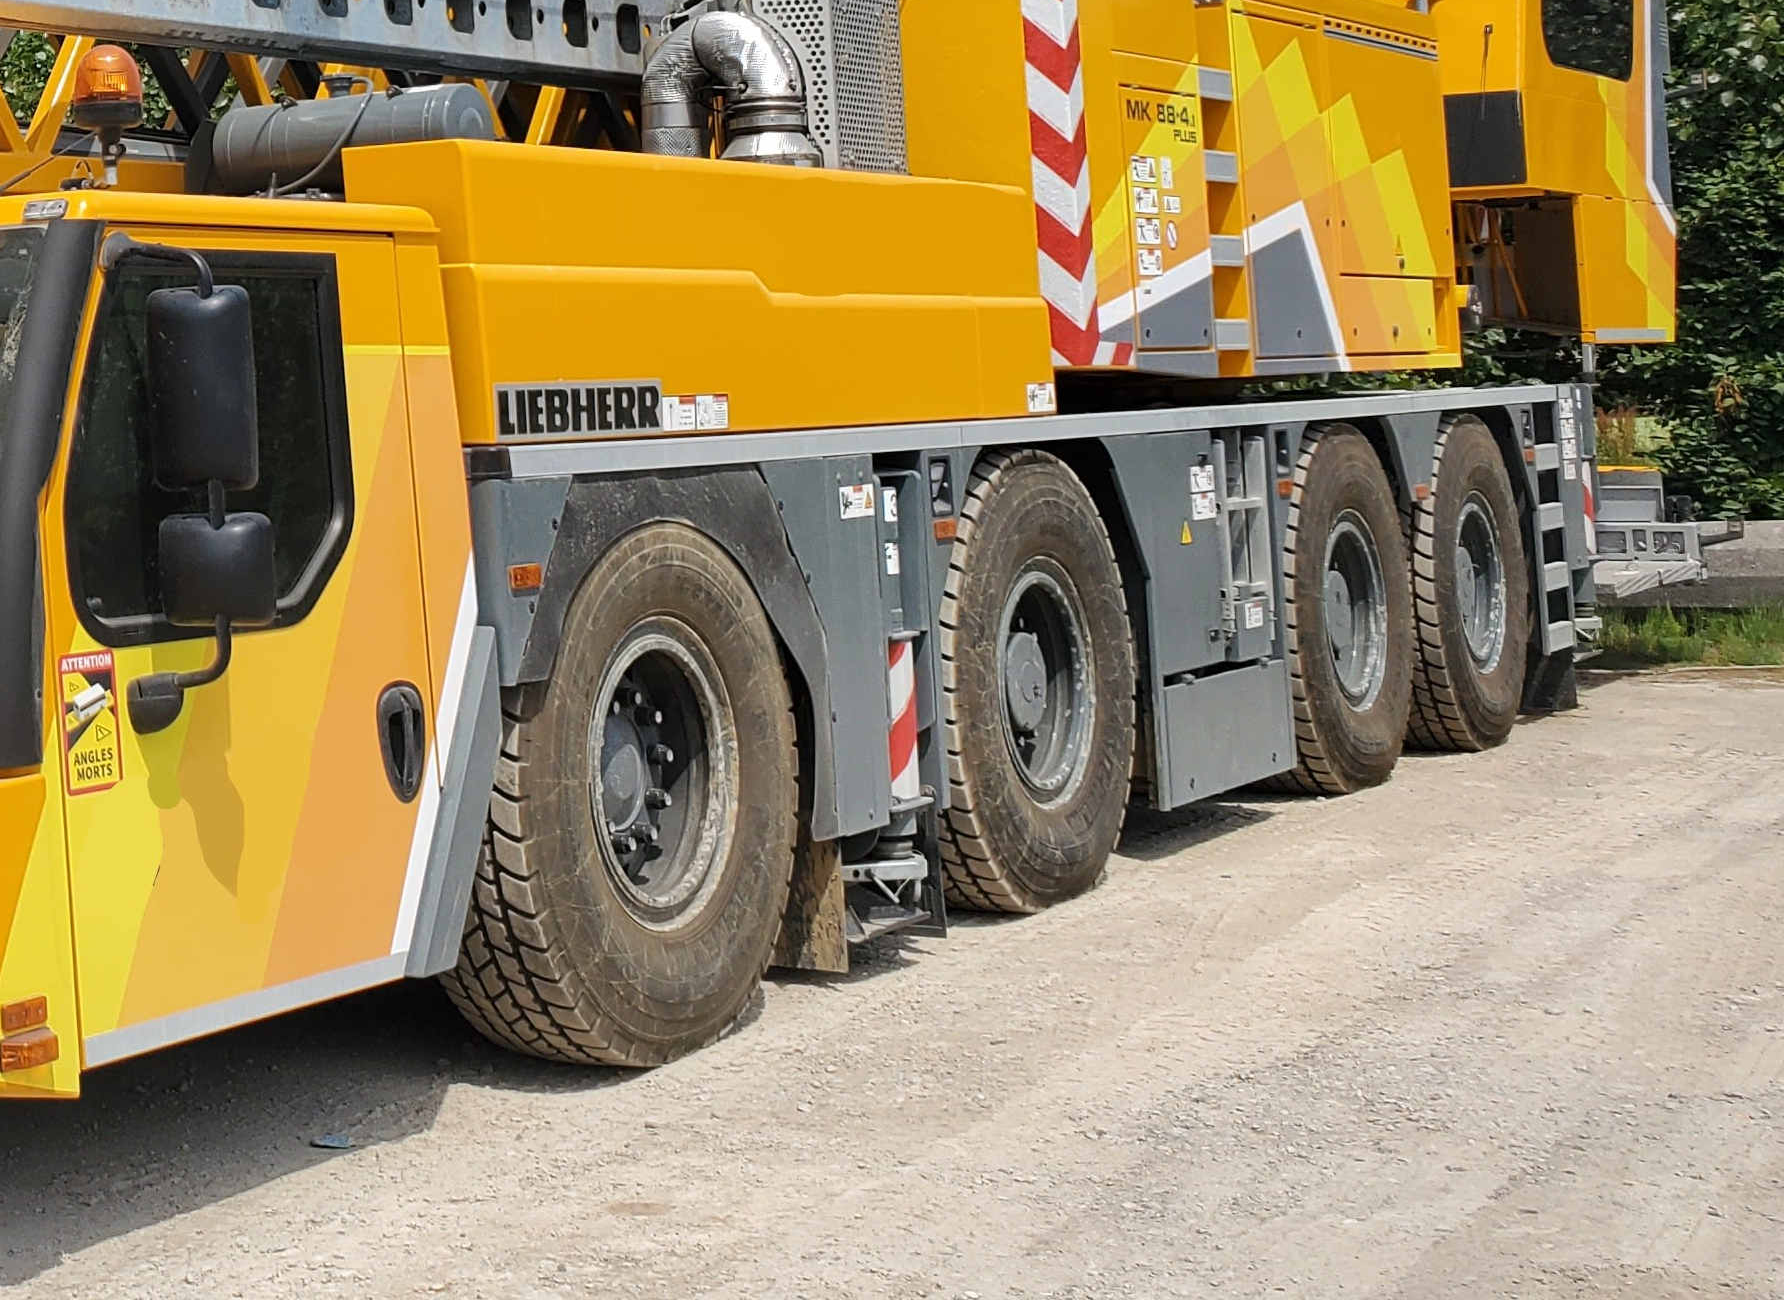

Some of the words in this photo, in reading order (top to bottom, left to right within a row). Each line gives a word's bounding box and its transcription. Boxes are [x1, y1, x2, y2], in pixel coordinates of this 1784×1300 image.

[1126, 99, 1151, 122] MK
[1173, 129, 1197, 143] PLUS
[497, 385, 660, 435] LIEBHERR
[61, 653, 112, 672] ATTENTION
[74, 747, 114, 767] ANGLES
[76, 763, 113, 782] MORTS
